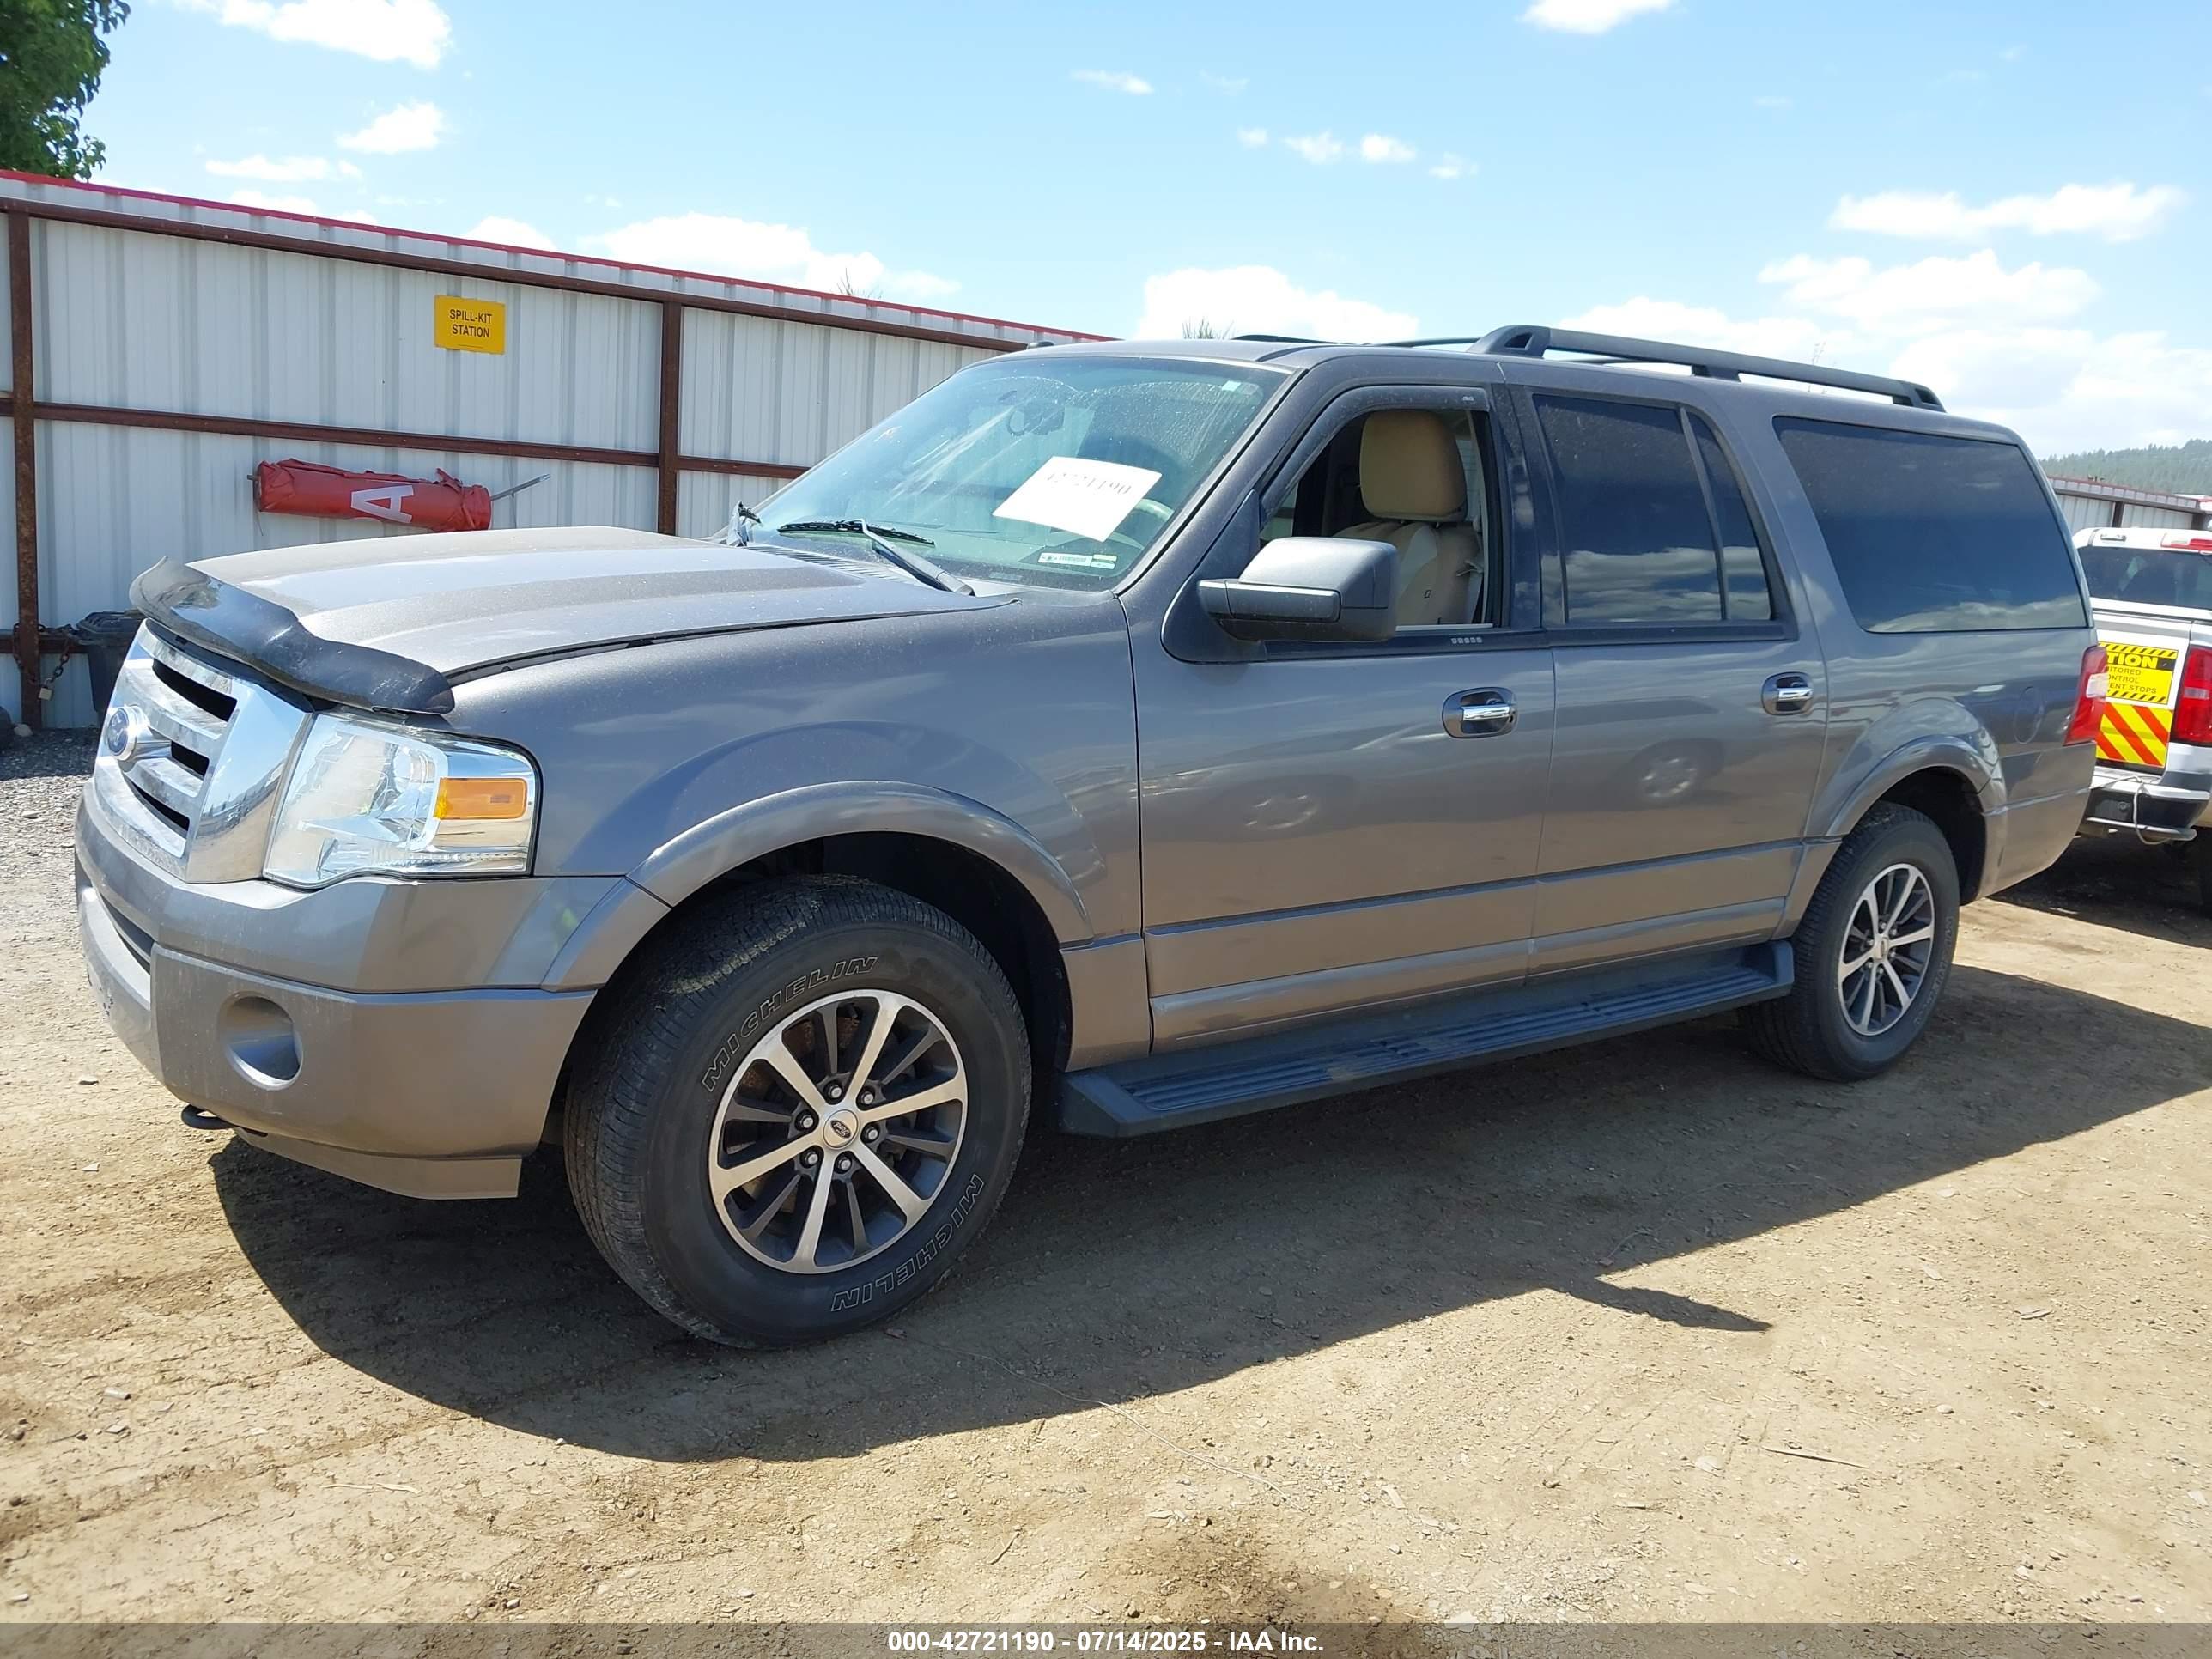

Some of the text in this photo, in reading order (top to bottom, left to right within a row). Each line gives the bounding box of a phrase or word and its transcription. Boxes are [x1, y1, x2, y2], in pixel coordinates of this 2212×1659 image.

[449, 308, 493, 324] SPILL-KIT
[452, 324, 489, 337] STATION
[351, 484, 414, 524] A
[2107, 652, 2159, 669] TION
[2130, 685, 2157, 694] STOPS
[702, 957, 878, 1092] MICHELIN
[830, 1173, 984, 1312] MICHELIN
